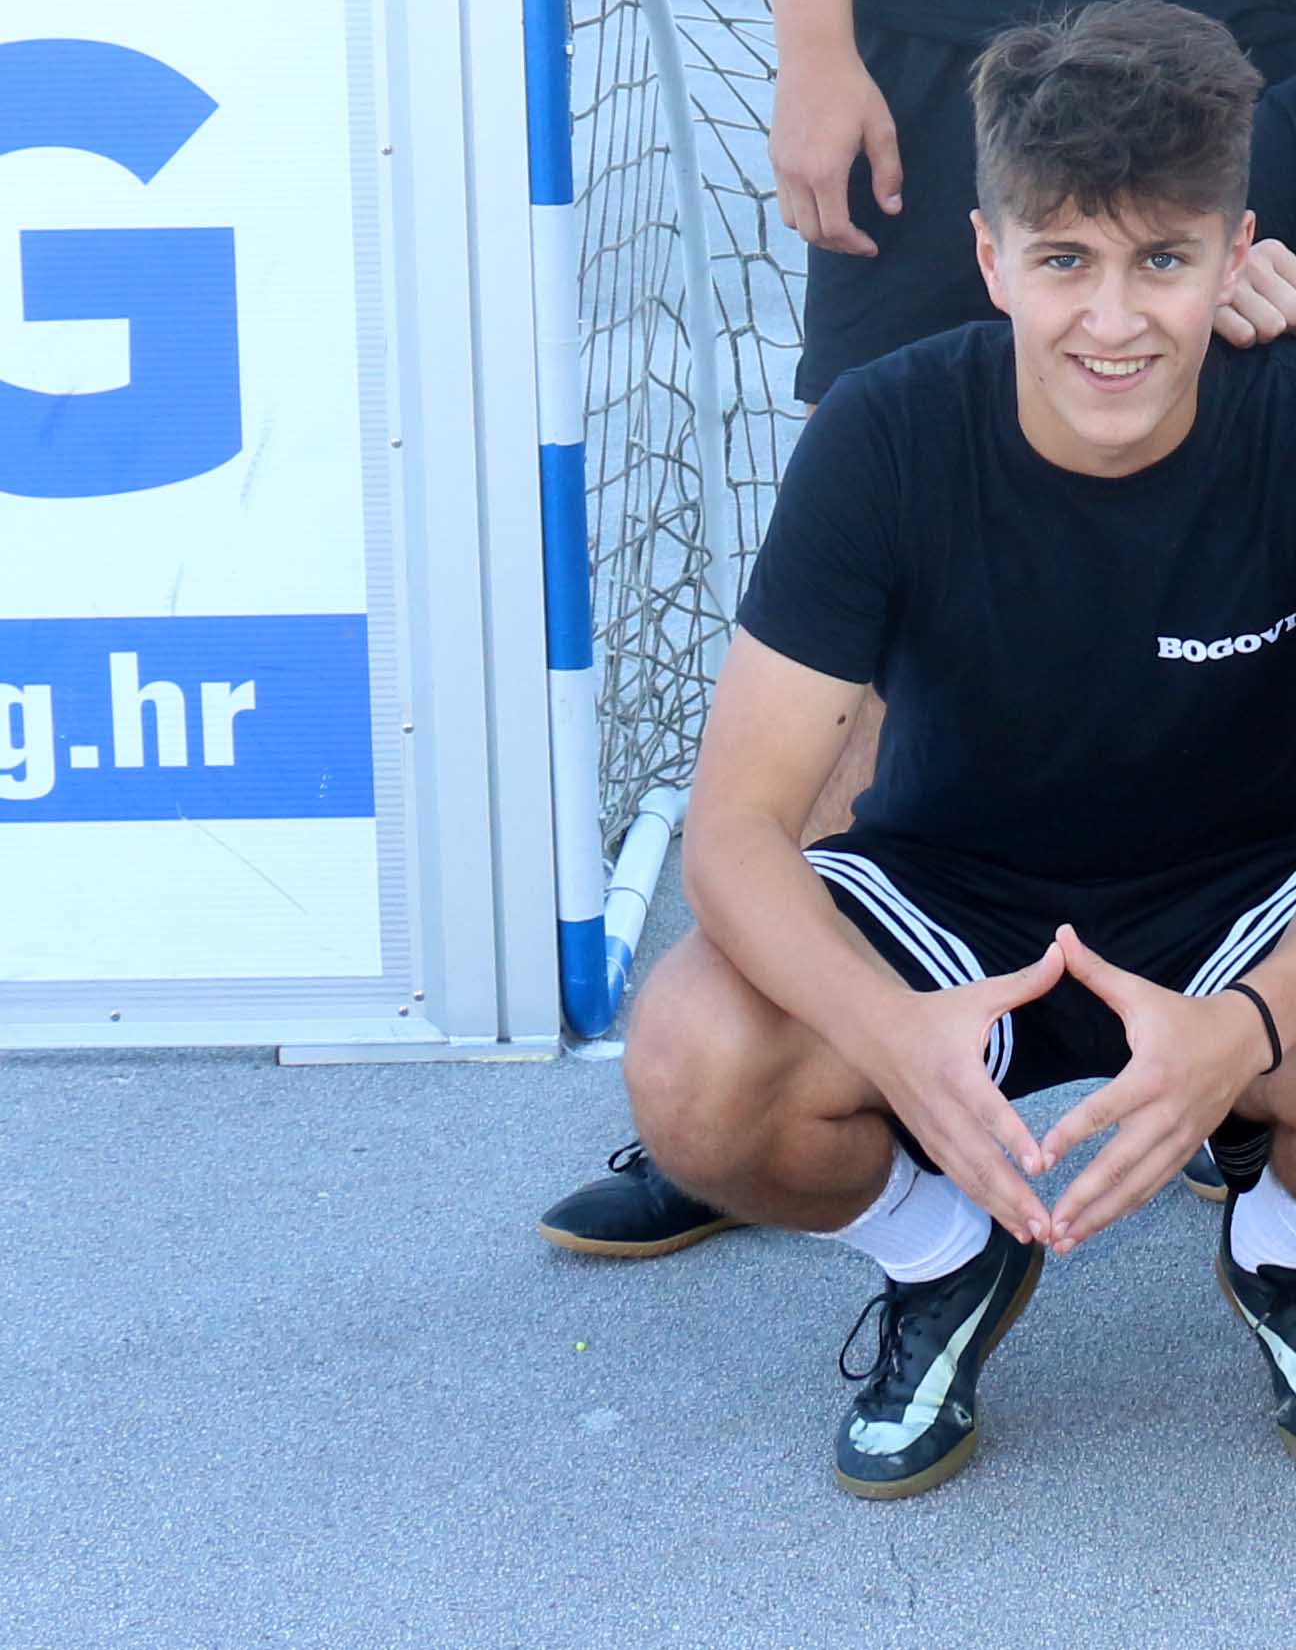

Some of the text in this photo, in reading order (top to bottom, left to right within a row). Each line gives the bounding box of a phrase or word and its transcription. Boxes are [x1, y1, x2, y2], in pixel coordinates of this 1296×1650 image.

[0, 38, 243, 499] G
[1157, 612, 1296, 662] BOGOVI
[0, 651, 256, 800] g.hr
